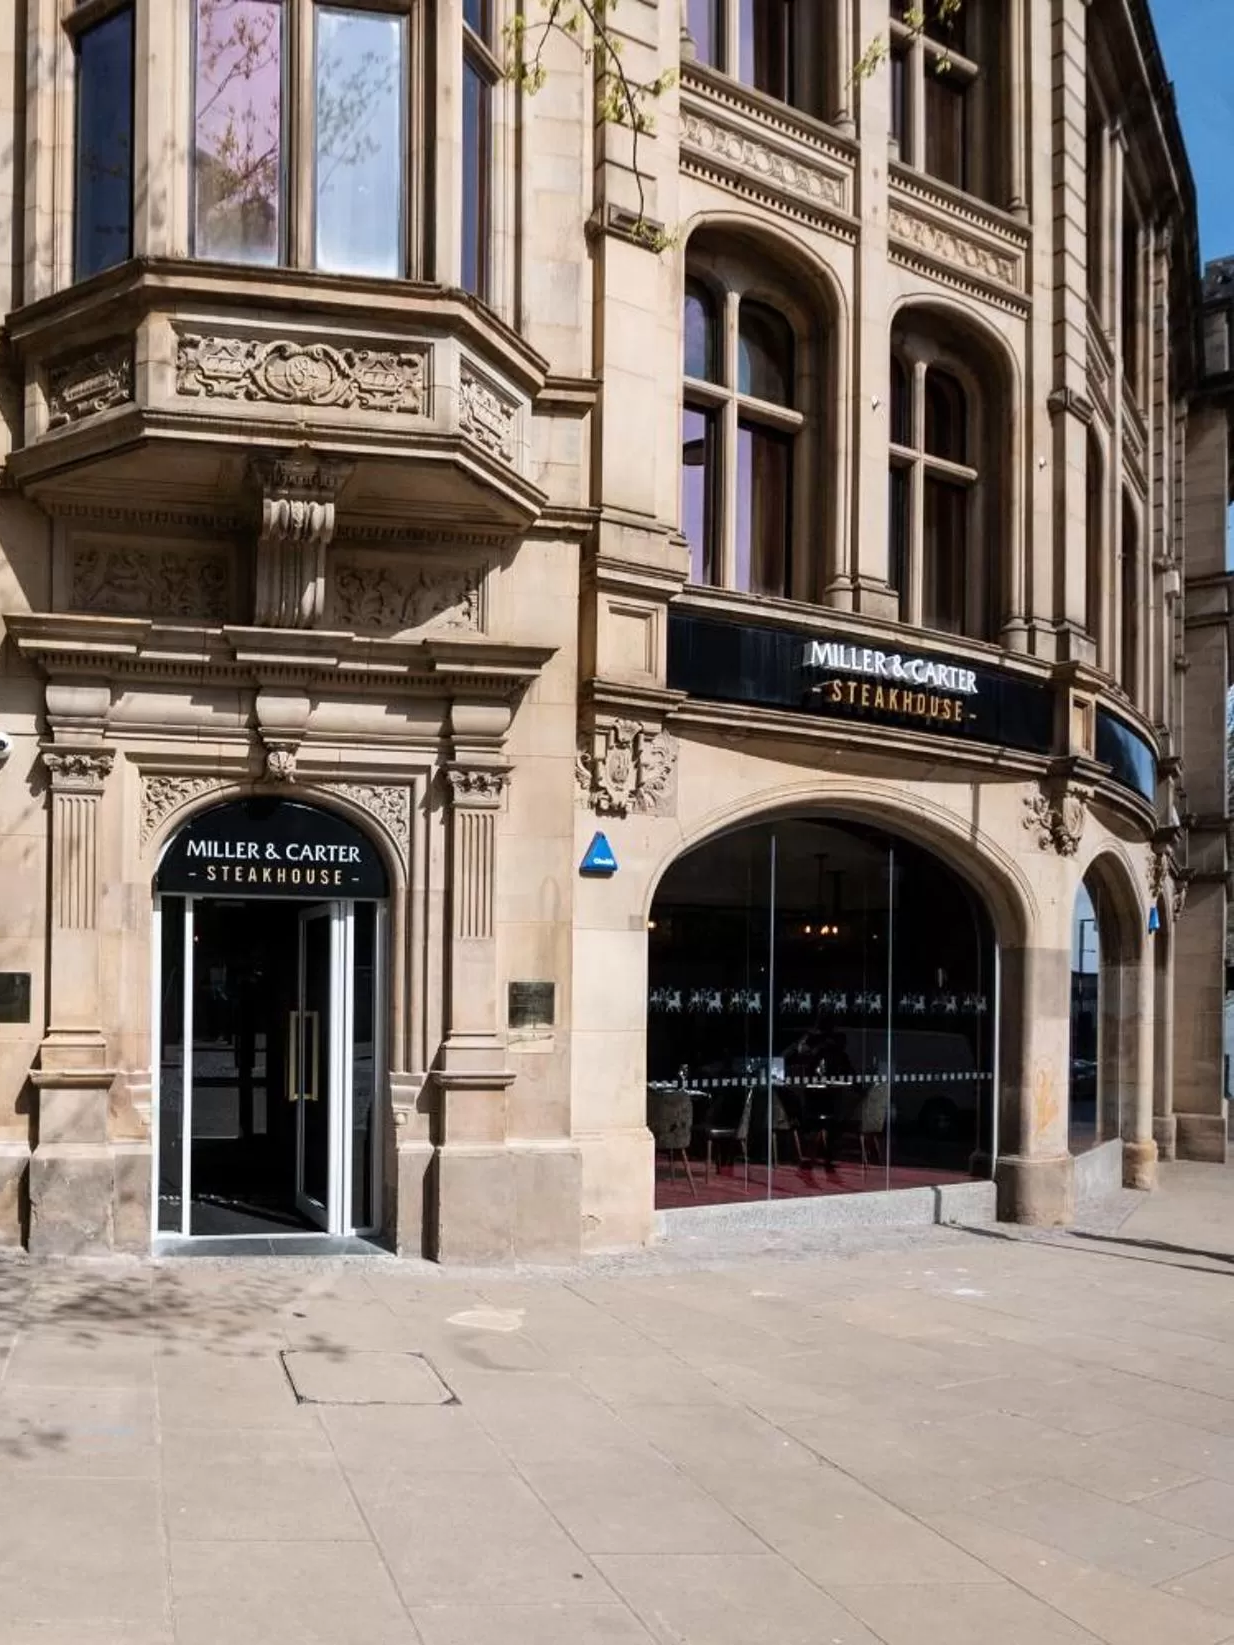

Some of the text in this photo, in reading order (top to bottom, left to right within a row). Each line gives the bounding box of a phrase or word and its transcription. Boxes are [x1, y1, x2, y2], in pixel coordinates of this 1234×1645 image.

[809, 640, 979, 694] MILLER & CARTER
[831, 678, 964, 722] STEAKHOUSE
[186, 839, 362, 863] MILLER & CARTER
[206, 865, 343, 885] STEAKHOUSE
